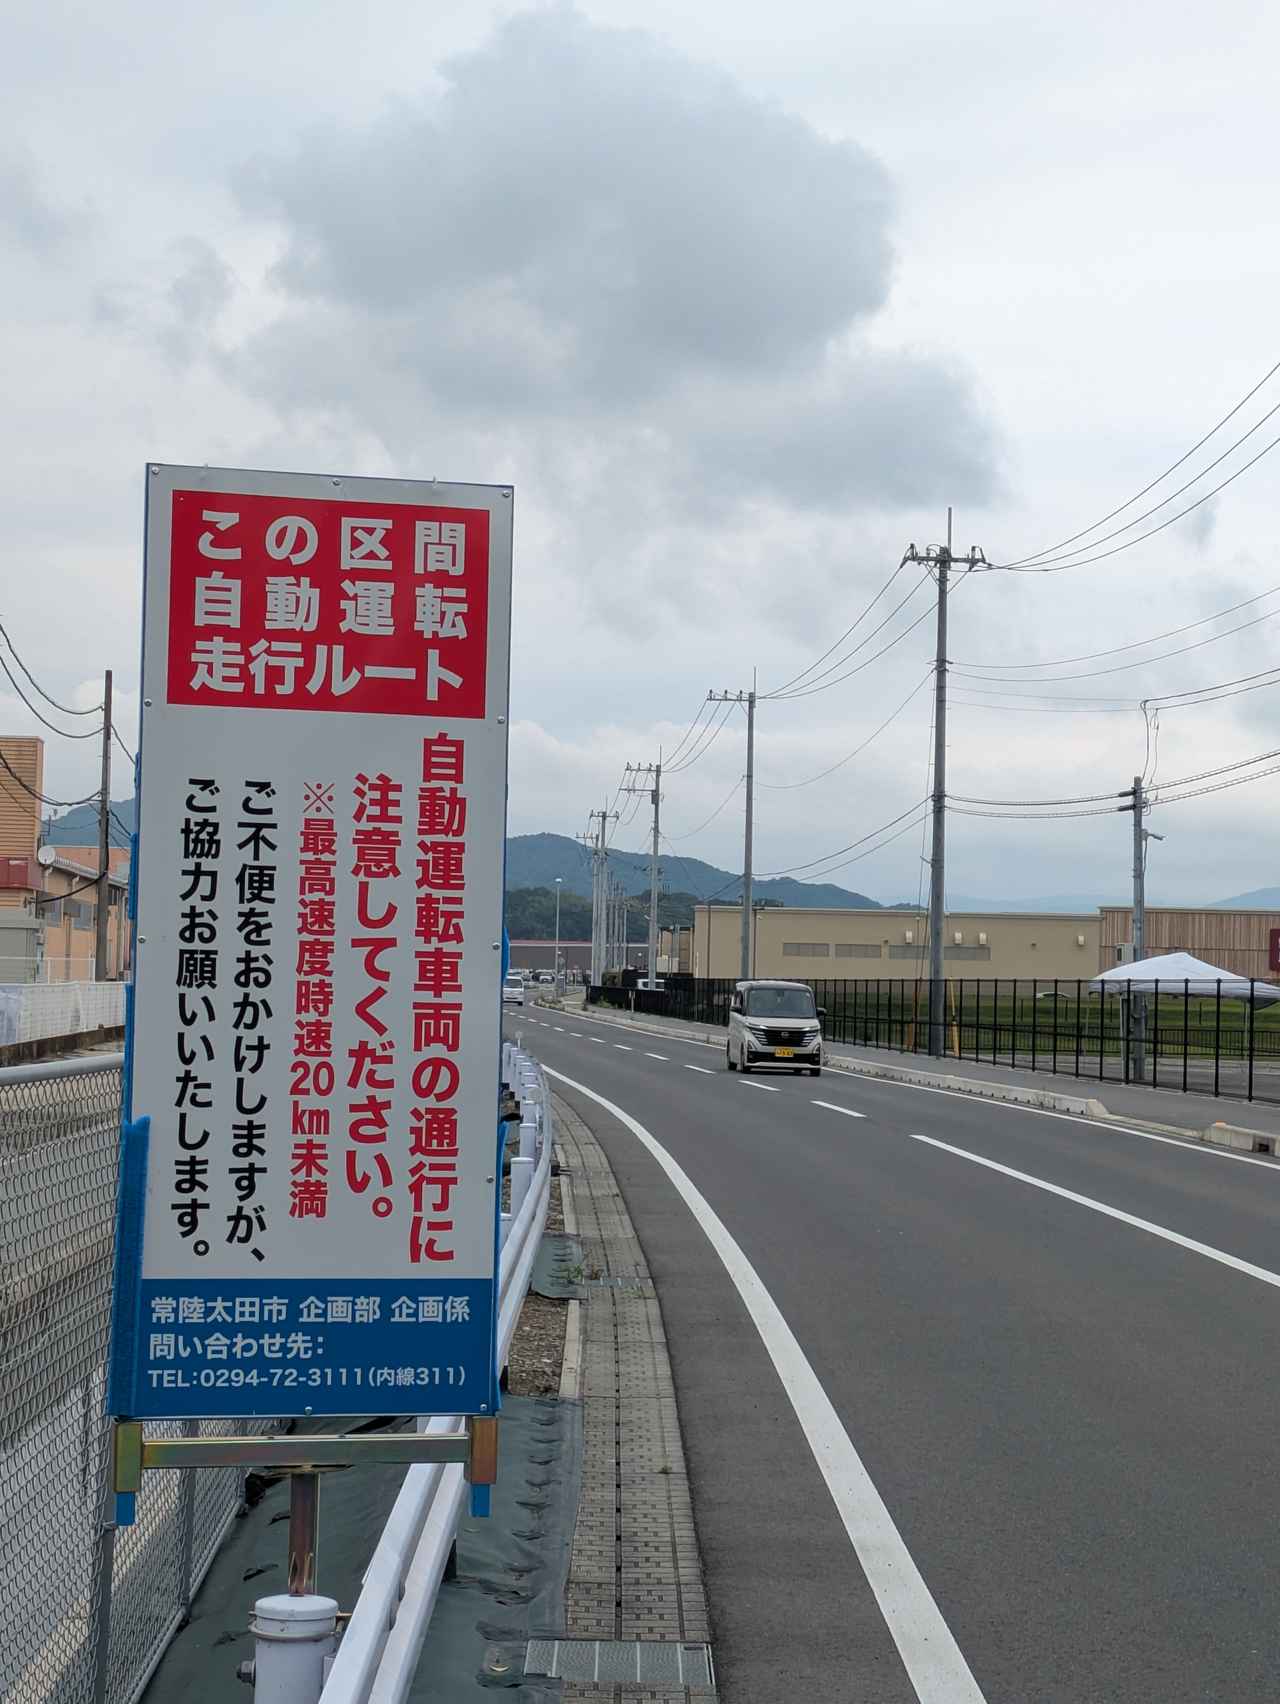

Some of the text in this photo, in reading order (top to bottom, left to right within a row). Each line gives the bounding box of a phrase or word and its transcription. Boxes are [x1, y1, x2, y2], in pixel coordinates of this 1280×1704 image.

[198, 509, 466, 576] この区間
[194, 571, 468, 640] 自動運転
[190, 636, 463, 701] 走行ルート
[171, 778, 221, 1256] ご協力お願いいたします。
[226, 780, 278, 1261] ご不便をおかけしますが、
[346, 773, 402, 1217] 注意してください。
[408, 732, 467, 1263] 自動運転車両の通行に
[151, 1296, 471, 1323] 常陸太田市 企画部 企画係
[149, 1333, 324, 1360] 問い合わせ先:
